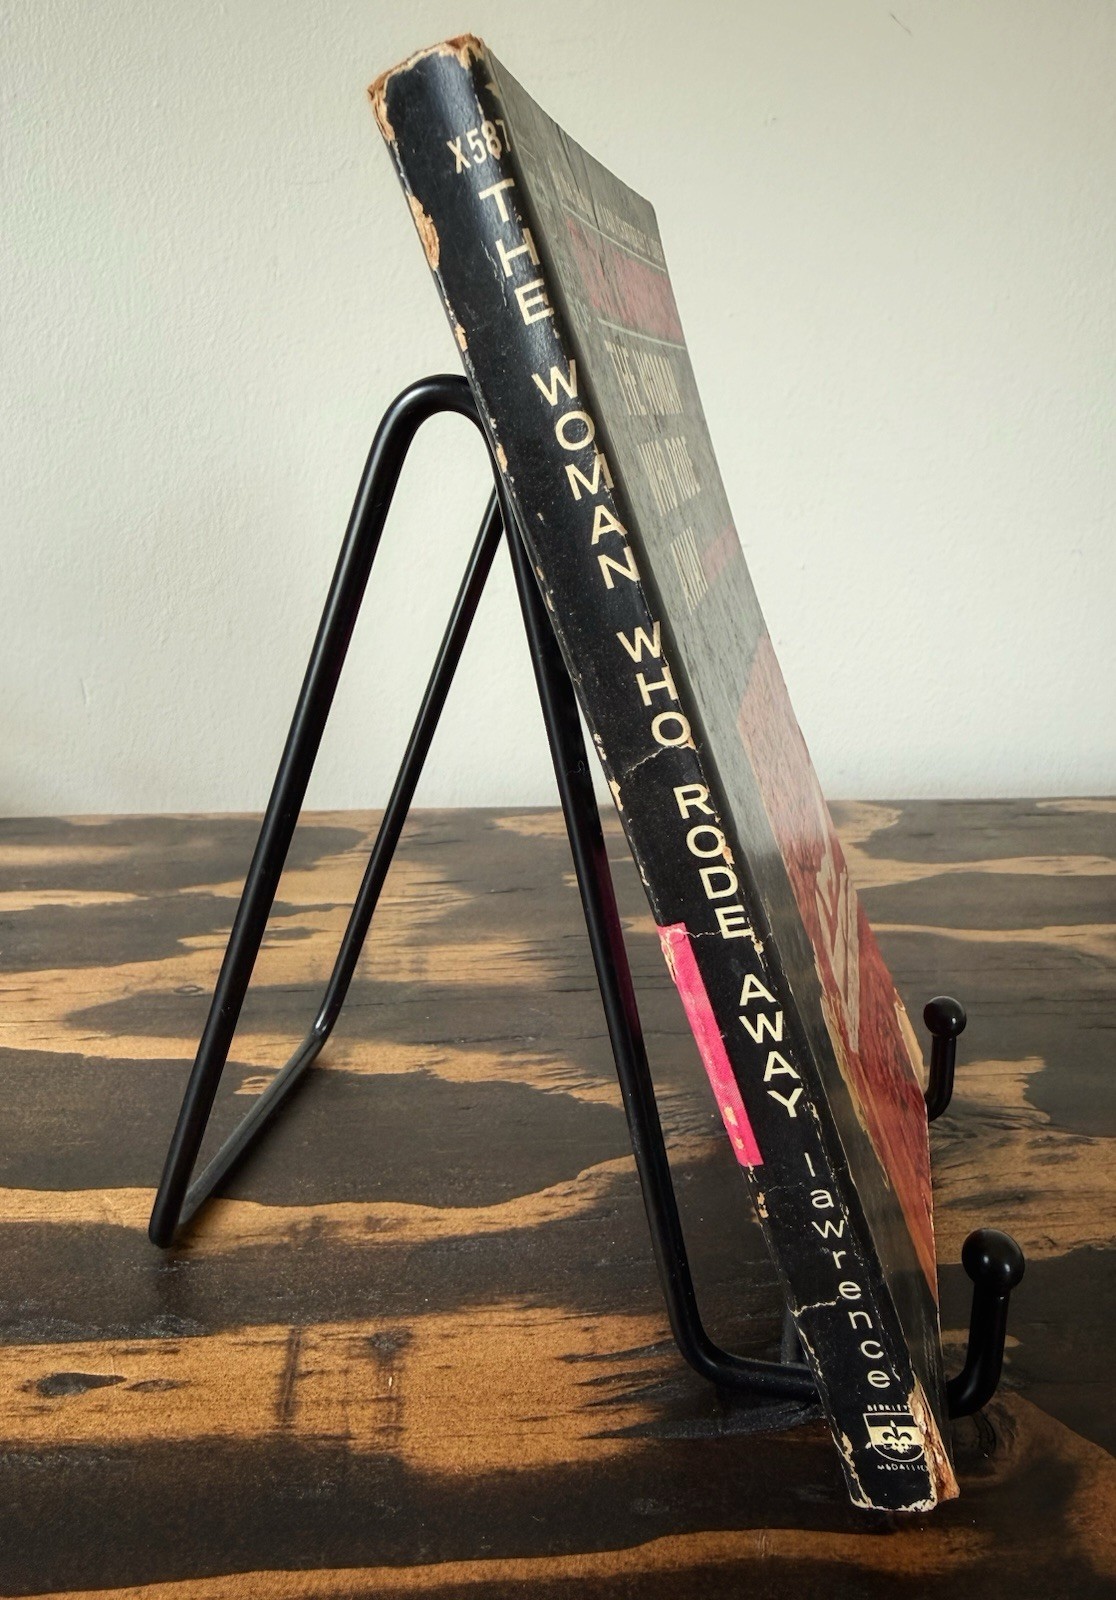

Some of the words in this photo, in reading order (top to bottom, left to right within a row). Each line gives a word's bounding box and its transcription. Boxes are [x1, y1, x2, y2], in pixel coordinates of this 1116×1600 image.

[447, 119, 511, 174] X587
[478, 178, 554, 325] THE
[531, 359, 641, 589] WOMAN
[616, 621, 691, 746] WHO
[673, 783, 752, 940] RODE
[739, 973, 803, 1118] AWAY
[804, 1152, 891, 1389] lawrence
